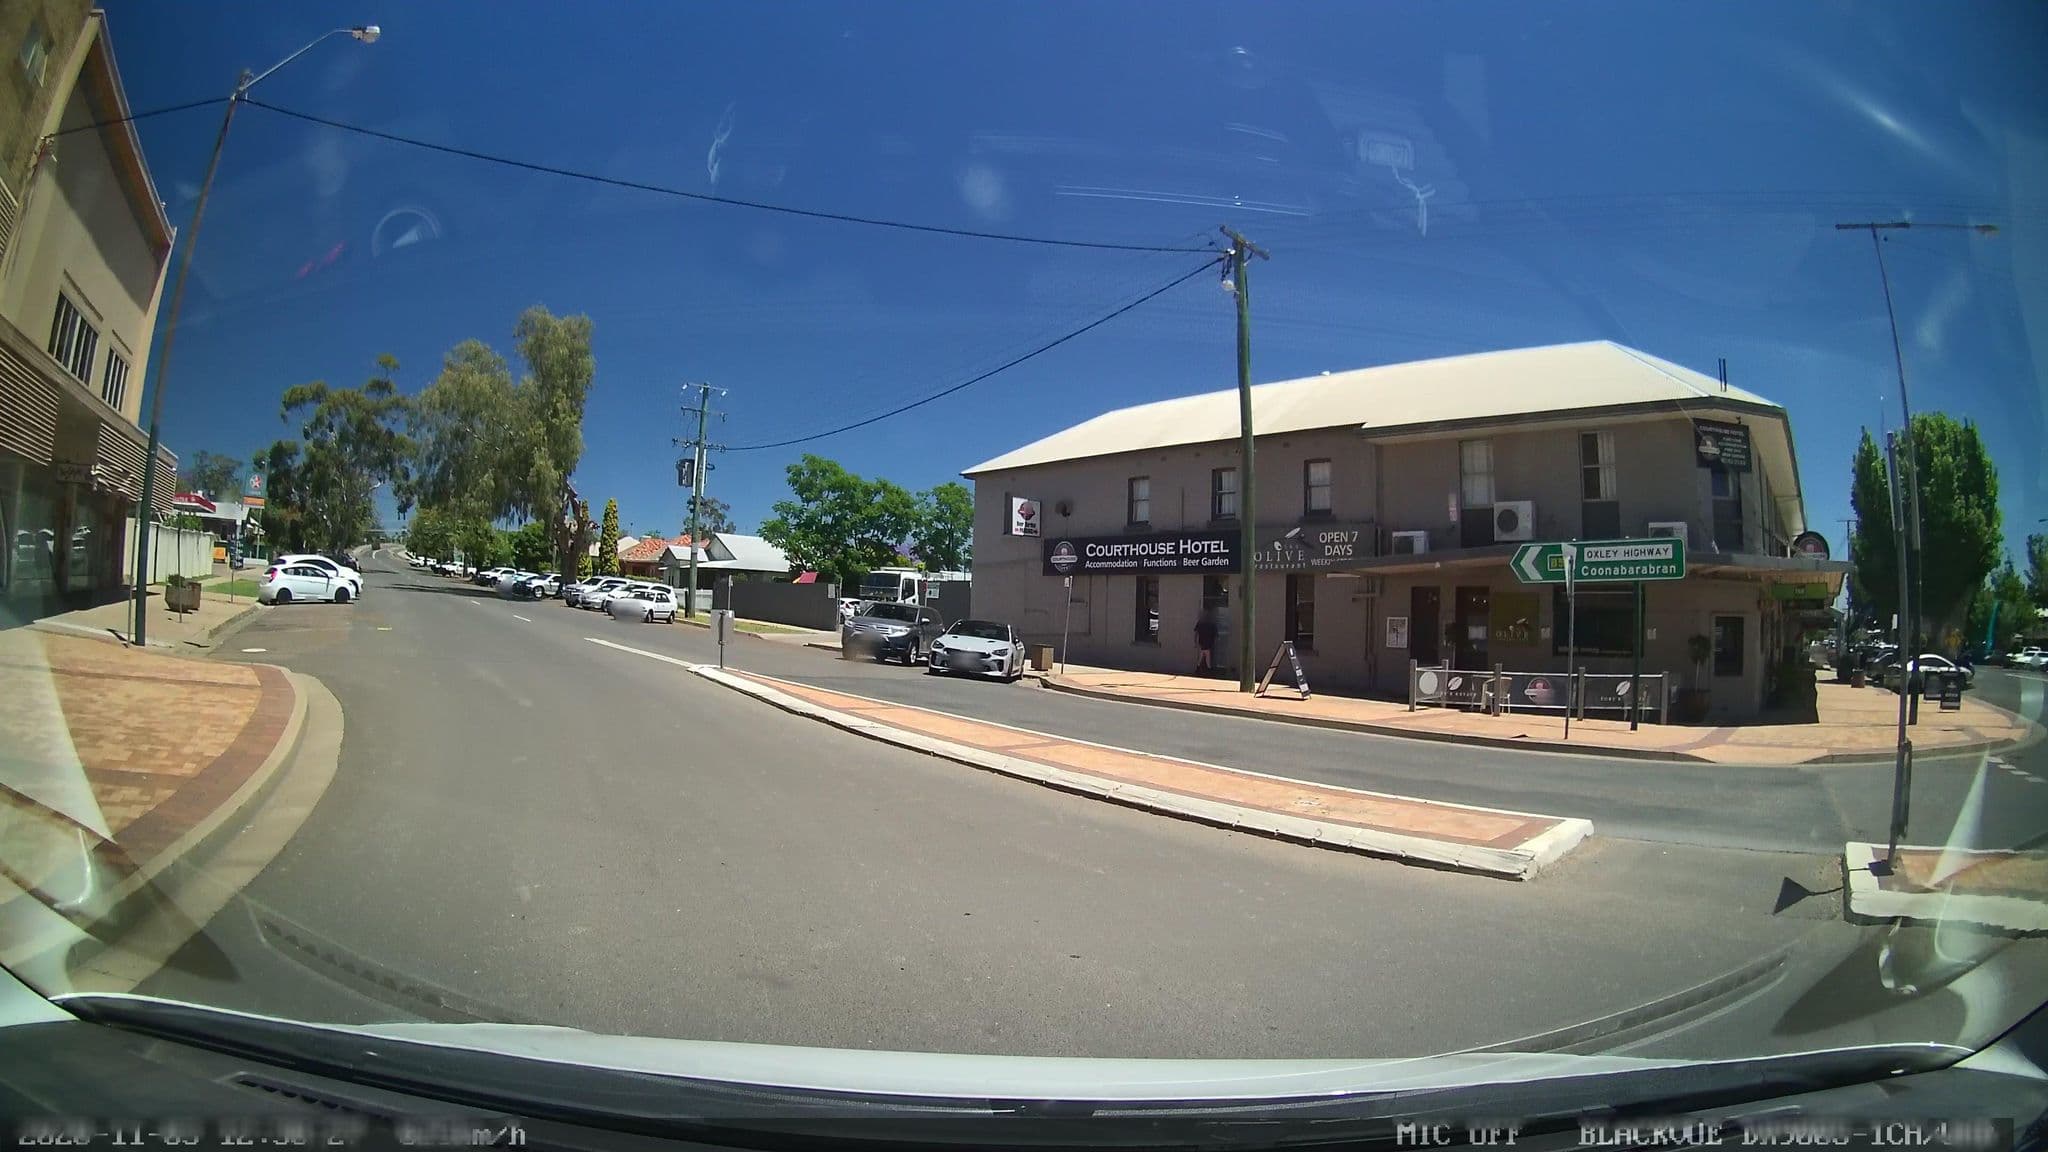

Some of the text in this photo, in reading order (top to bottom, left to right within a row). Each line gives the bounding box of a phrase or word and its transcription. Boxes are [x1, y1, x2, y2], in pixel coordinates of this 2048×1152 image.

[1319, 531, 1358, 544] OPEN 7
[1086, 539, 1229, 557] COURTHOUSE HOTEL
[1325, 545, 1352, 556] DAYS
[1586, 547, 1669, 559] OXLEY HIGHWAY
[1085, 555, 1229, 569] Accommodation Functions Beer Garden
[1253, 550, 1305, 562] OLIVE
[1581, 563, 1677, 576] Coonabarabran
